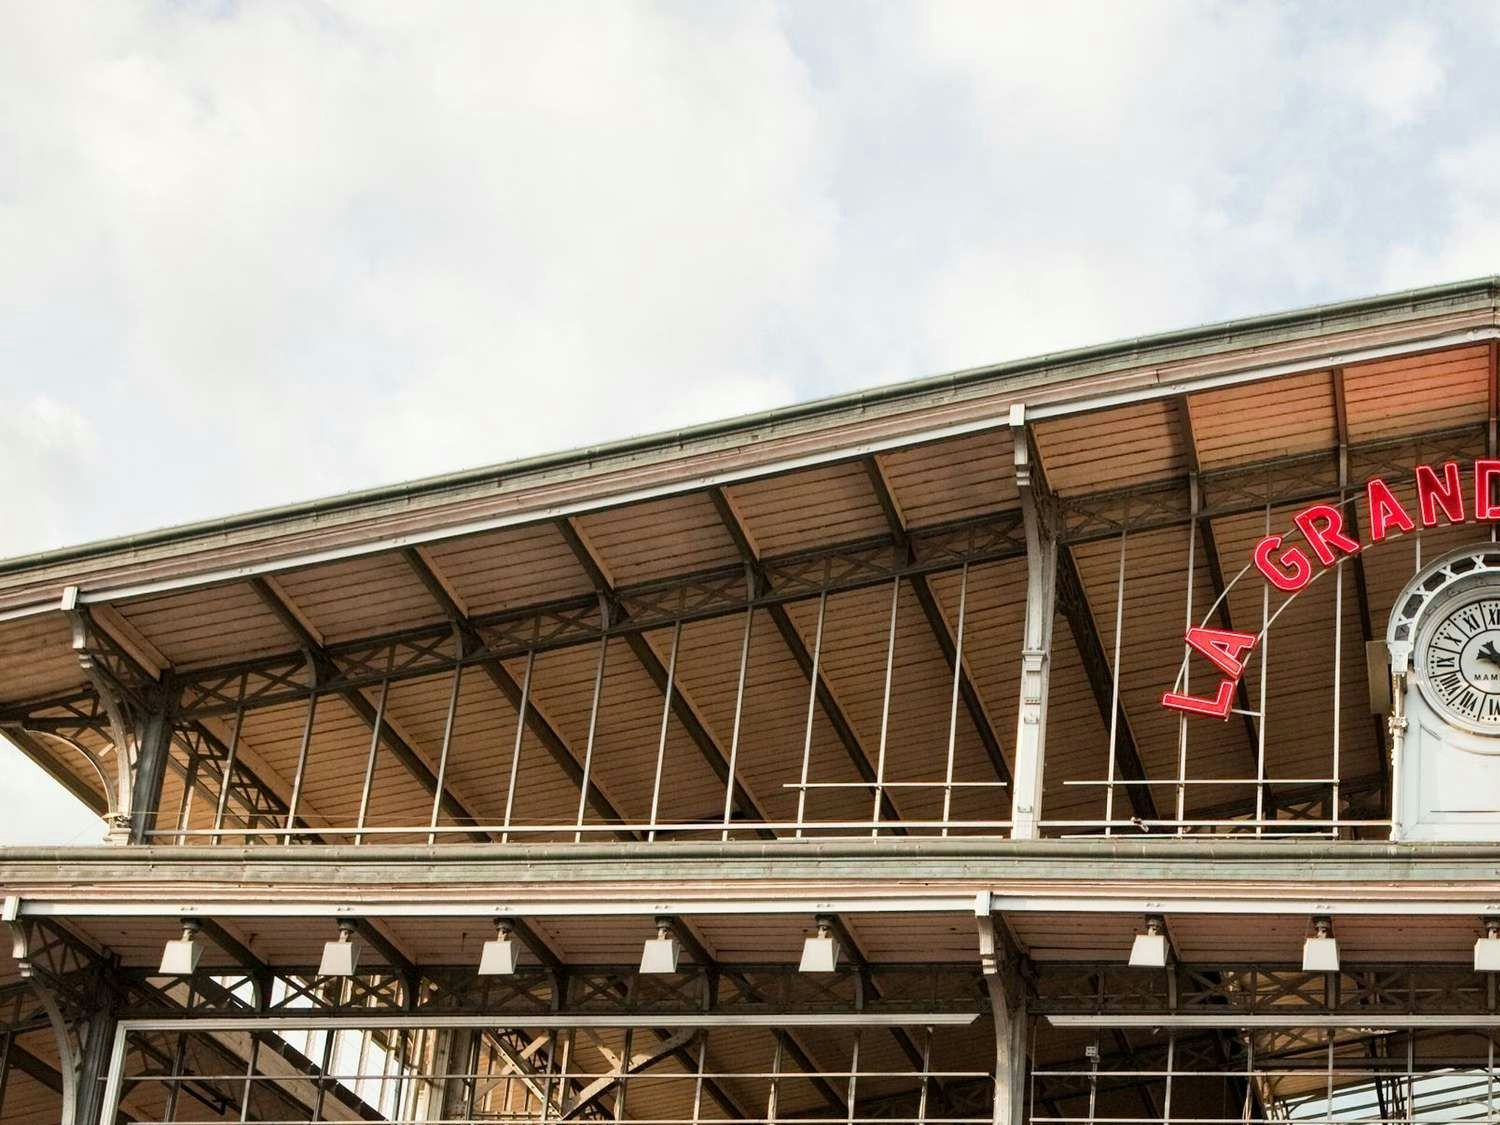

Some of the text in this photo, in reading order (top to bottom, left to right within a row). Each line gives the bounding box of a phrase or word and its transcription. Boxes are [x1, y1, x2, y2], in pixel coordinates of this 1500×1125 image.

[1463, 613, 1480, 632] XI
[1444, 633, 1462, 646] X
[1436, 656, 1455, 667] IX
[1161, 626, 1258, 720] LA
